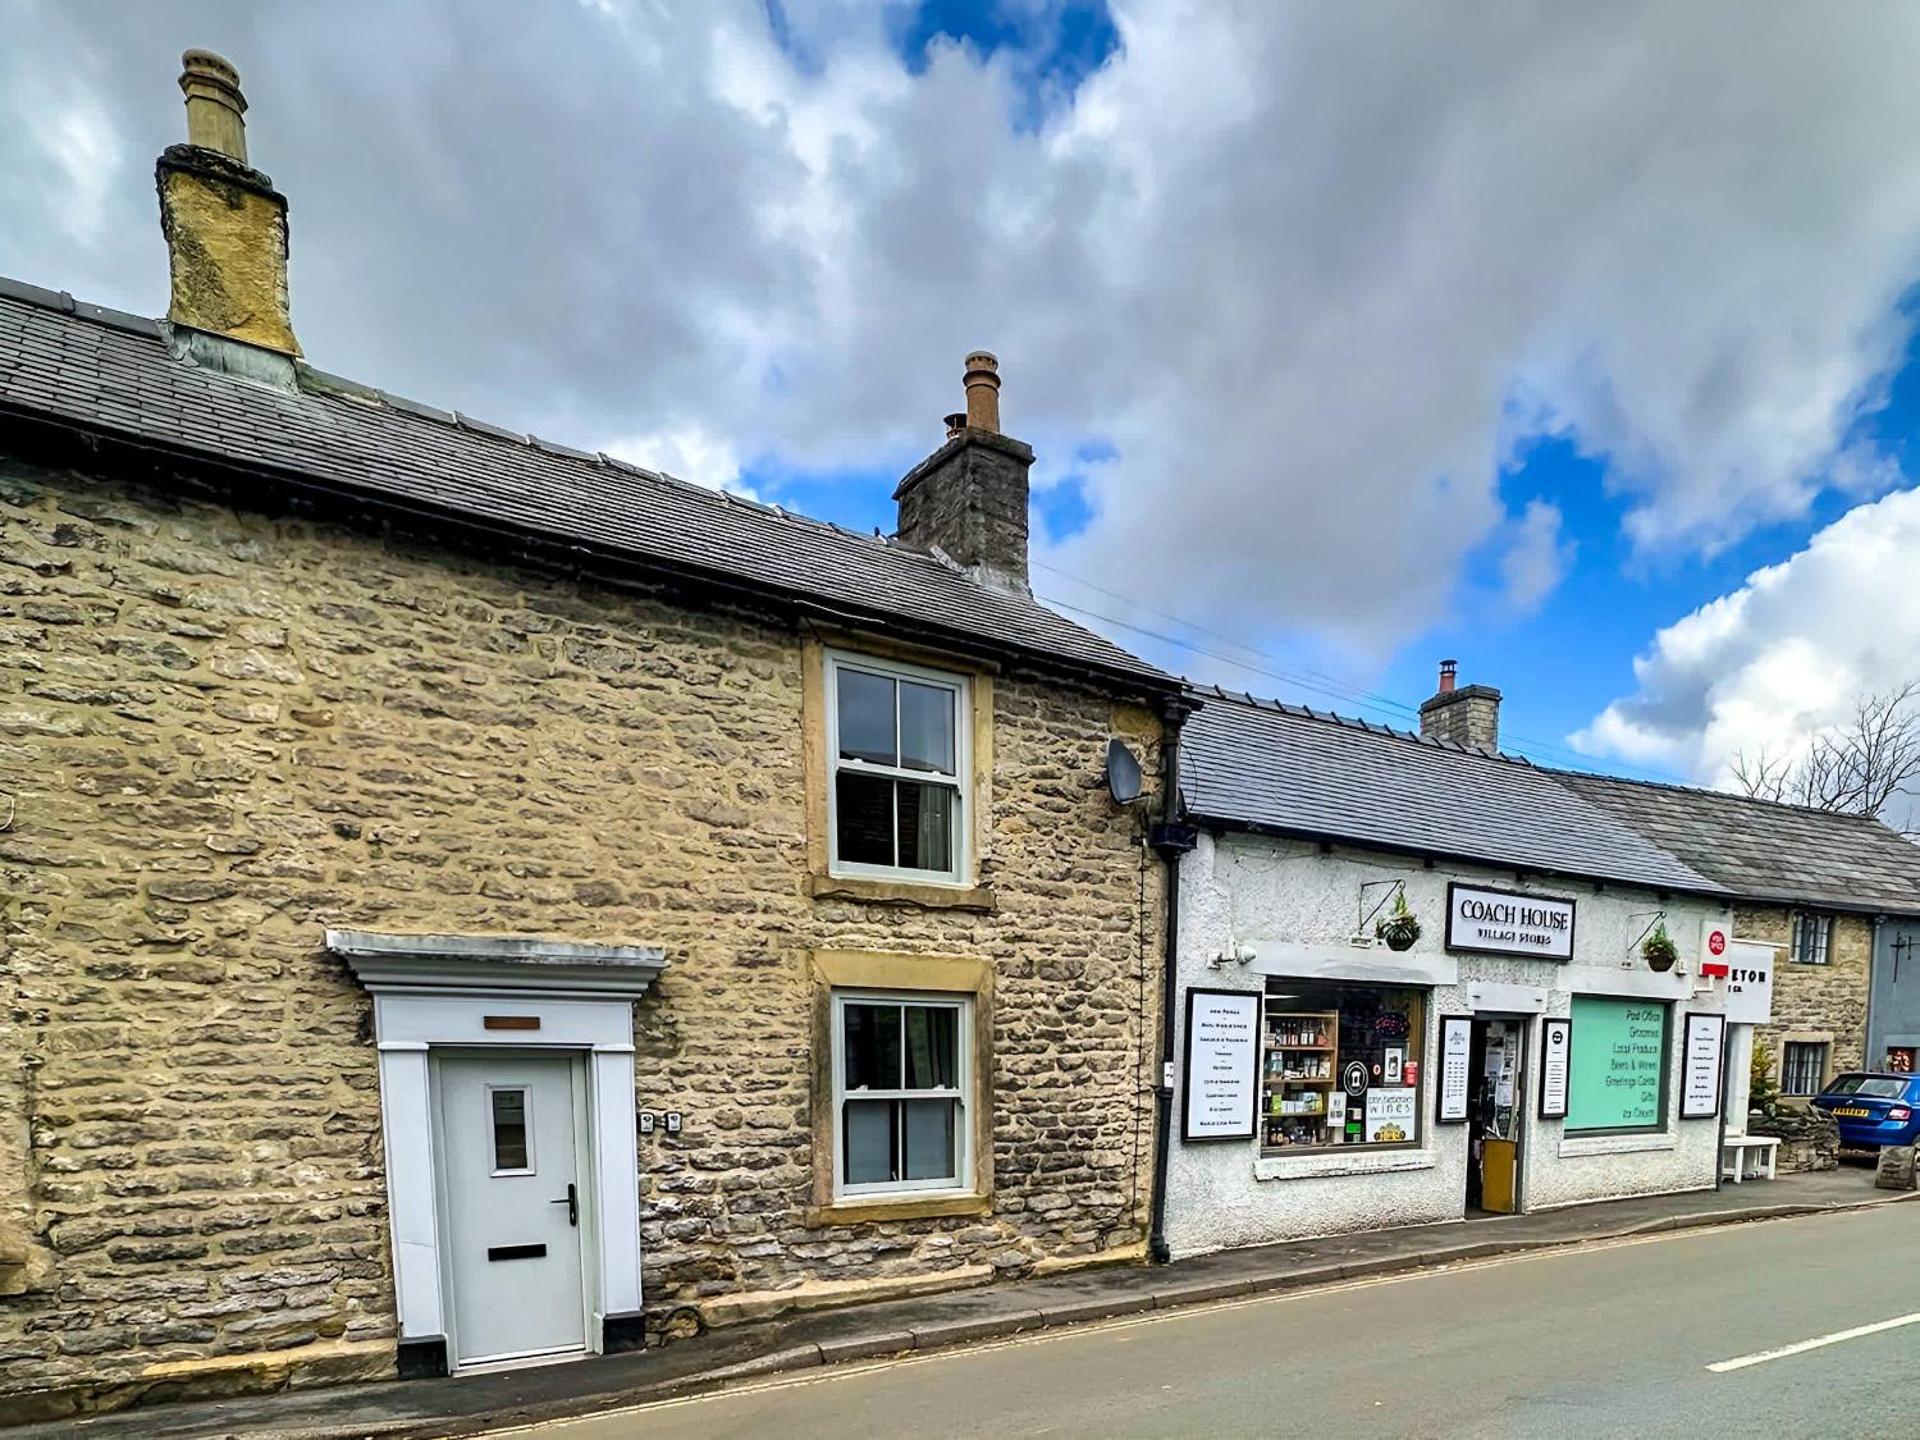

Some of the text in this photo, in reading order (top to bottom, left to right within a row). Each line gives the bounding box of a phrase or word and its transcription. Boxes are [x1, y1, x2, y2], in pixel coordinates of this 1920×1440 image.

[1461, 899, 1569, 931] COACH HOUSE
[1478, 928, 1516, 942] VILLAGE
